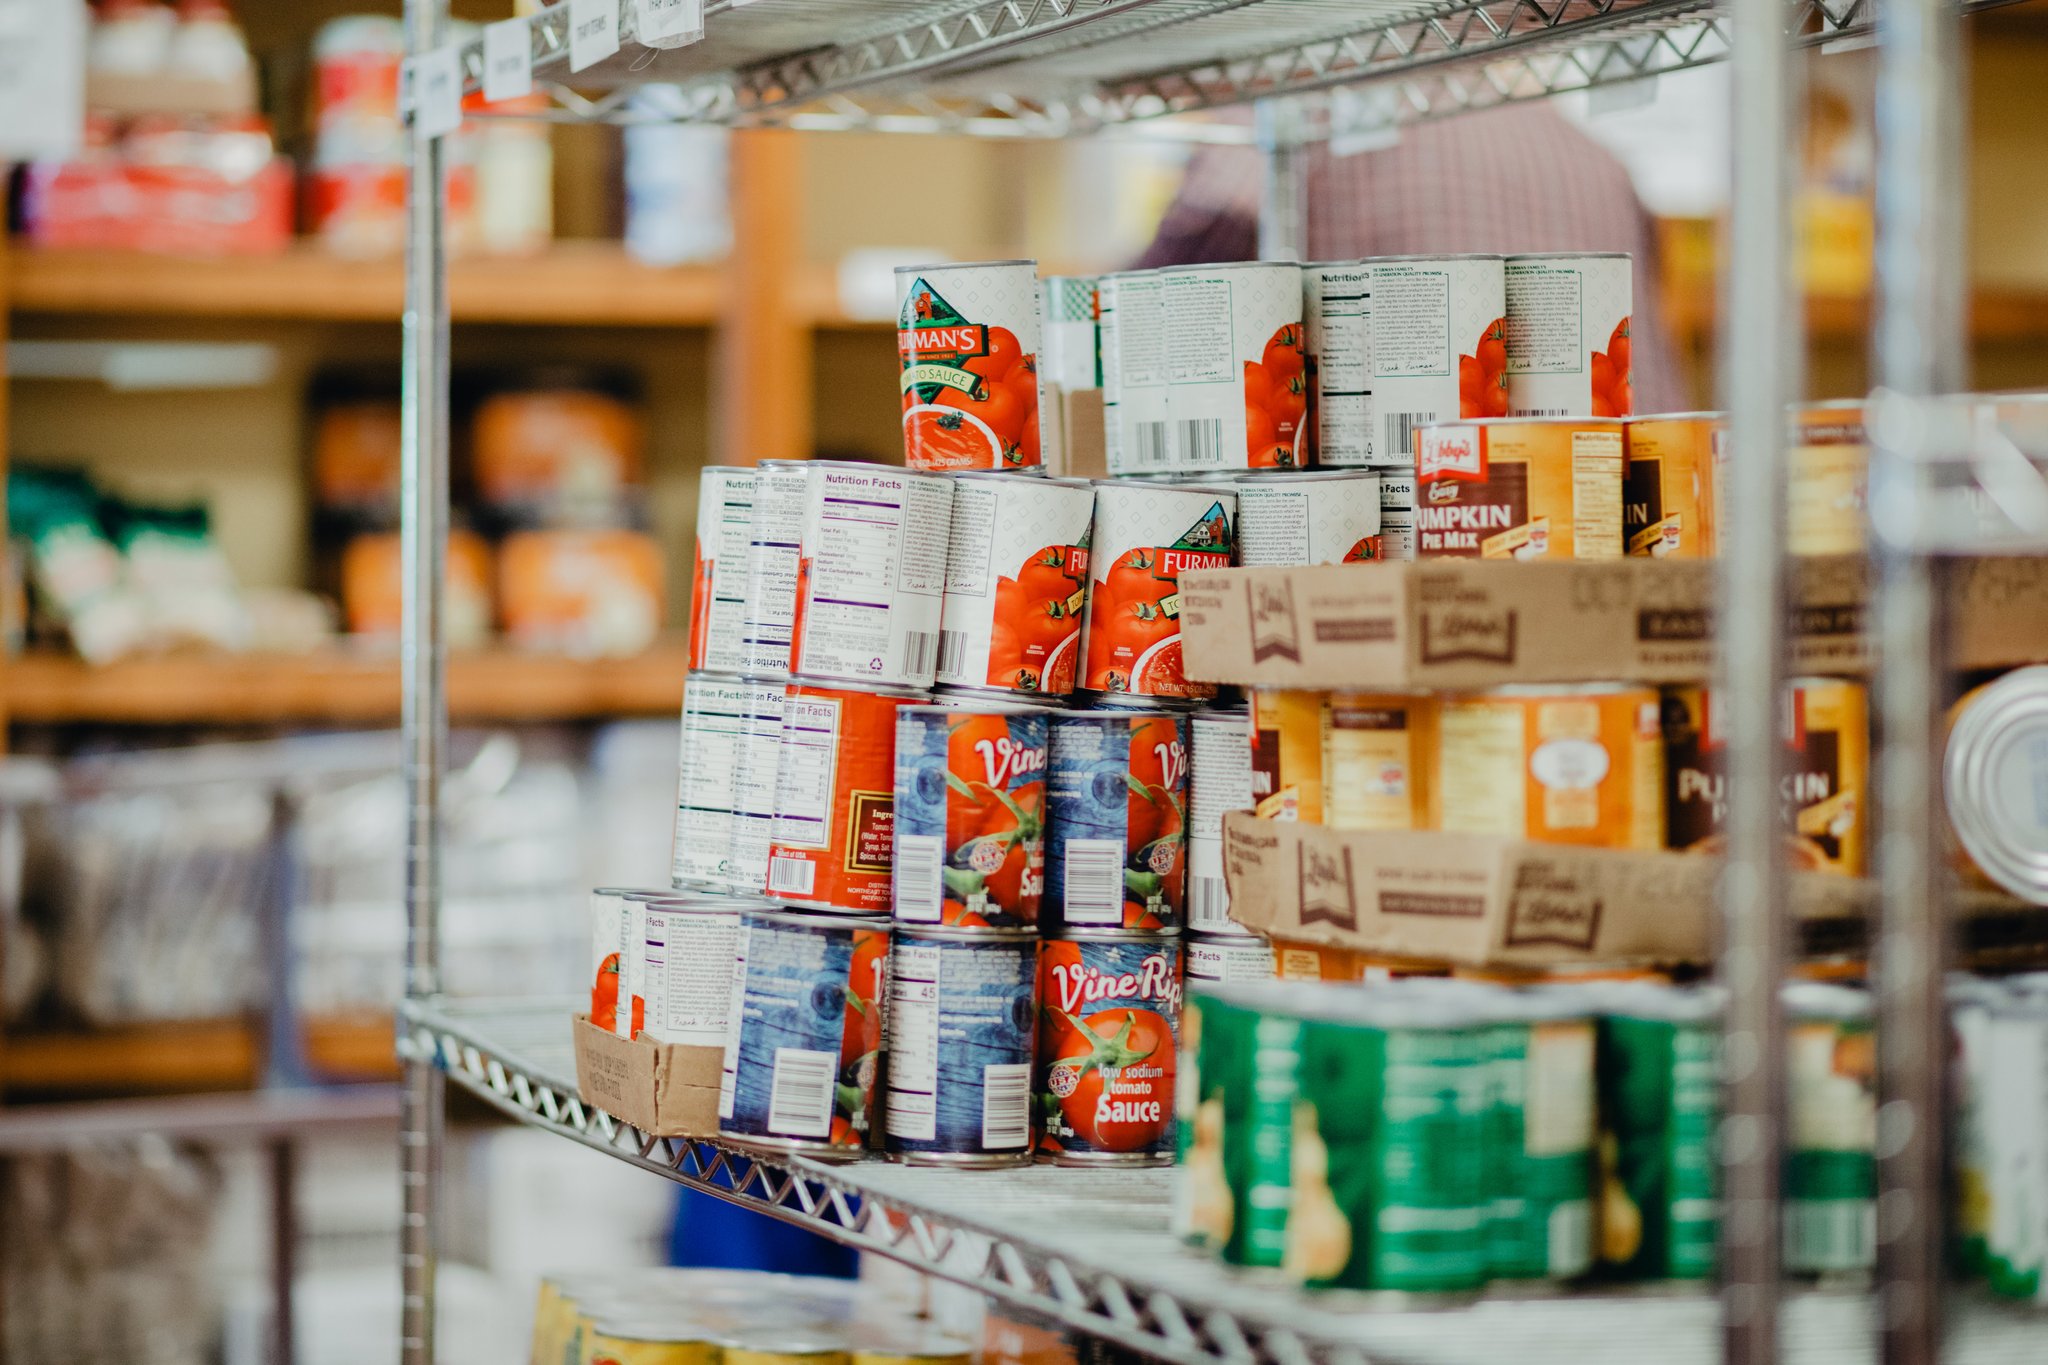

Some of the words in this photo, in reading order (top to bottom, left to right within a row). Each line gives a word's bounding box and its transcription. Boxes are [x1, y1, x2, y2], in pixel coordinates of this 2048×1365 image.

[928, 368, 967, 387] SAUCE
[825, 473, 869, 487] Nutrition
[871, 478, 903, 490] Facts
[1385, 483, 1411, 498] Facts
[1160, 682, 1173, 690] NET
[807, 709, 833, 719] Facts
[975, 737, 1046, 789] Vine
[913, 949, 938, 960] Facts
[1198, 949, 1221, 962] Facts
[920, 986, 936, 999] 45
[1052, 963, 1139, 1014] Vine
[1098, 1063, 1122, 1080] low
[1125, 1064, 1164, 1079] sodium
[1049, 1075, 1080, 1089] USA
[1110, 1080, 1153, 1096] tomato
[1097, 1093, 1161, 1124] Sauce
